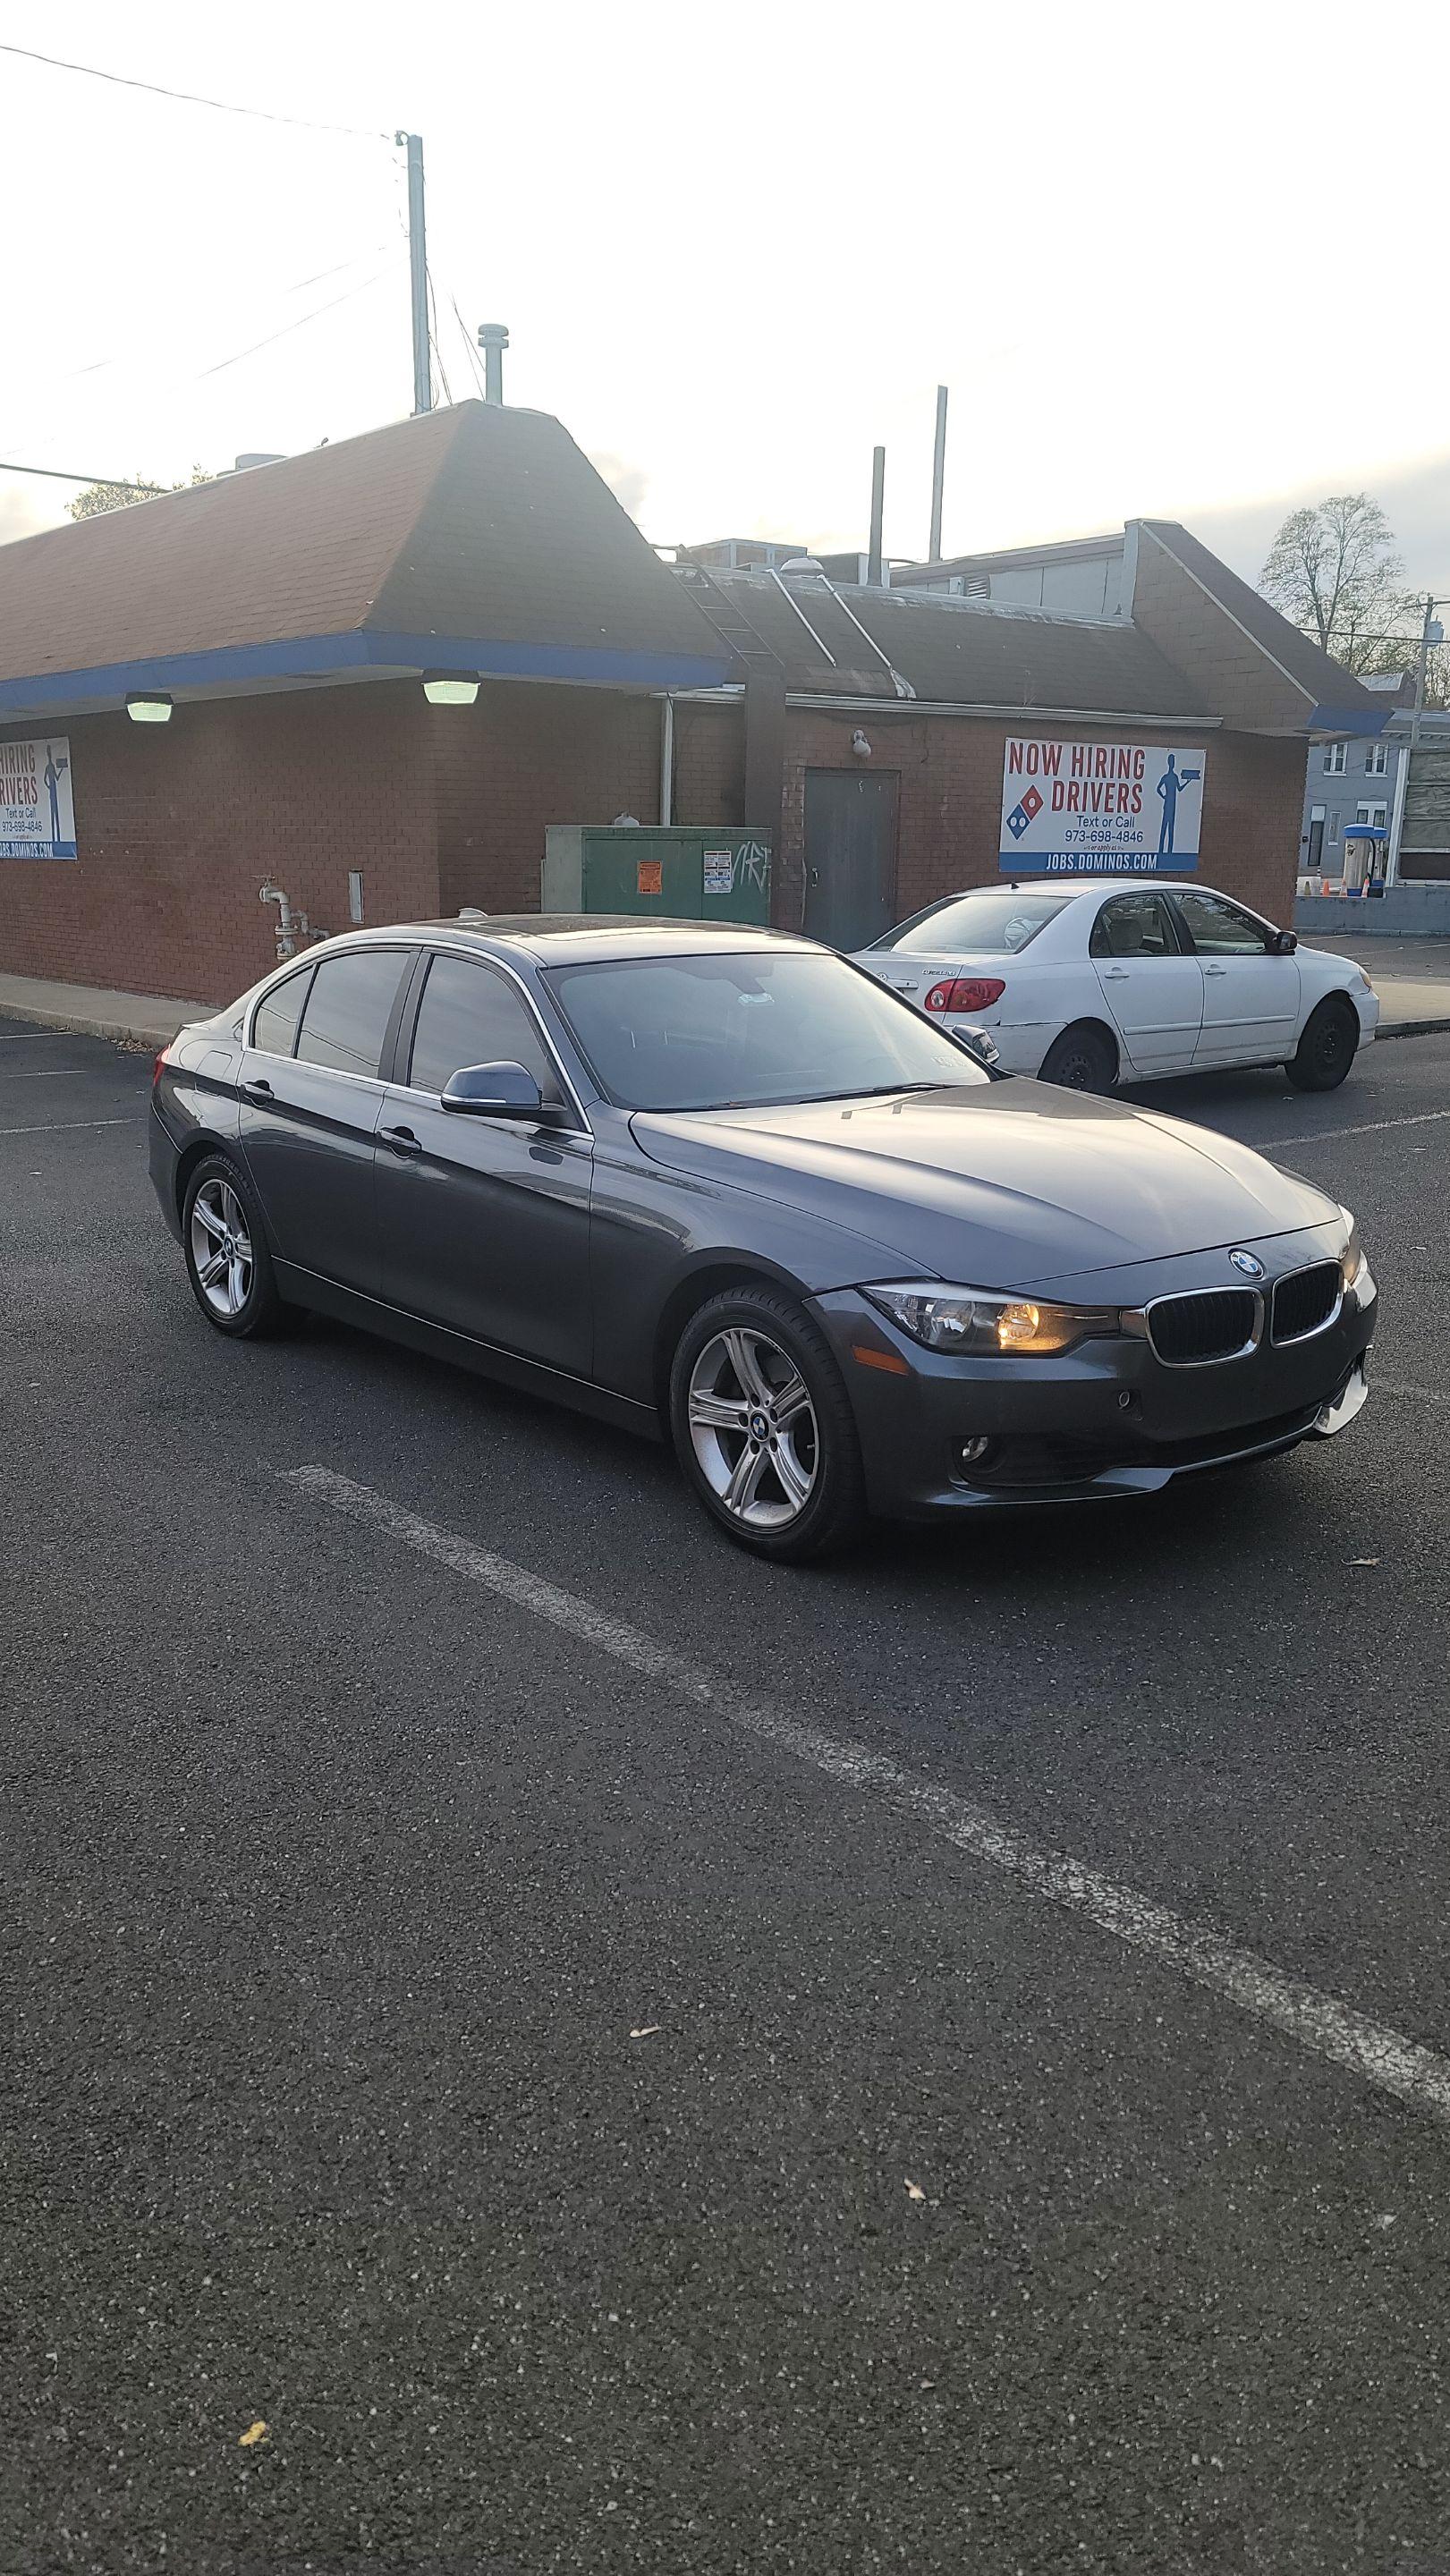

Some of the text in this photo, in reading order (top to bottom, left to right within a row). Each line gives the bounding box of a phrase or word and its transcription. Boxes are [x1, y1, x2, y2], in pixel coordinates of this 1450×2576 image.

[1008, 741, 1146, 780] NOW HIRING
[0, 776, 38, 805] RIVERS
[1051, 780, 1143, 814] DRIVERS
[5, 807, 37, 818] Text or Call
[2, 820, 43, 832] 973-698-4846
[1076, 815, 1135, 828] Text or Call
[1064, 830, 1144, 843] 973-698-4846
[0, 842, 54, 858] OBS.DOMINOS.COM
[1046, 853, 1157, 870] JOBS.DOMINOS.COM
